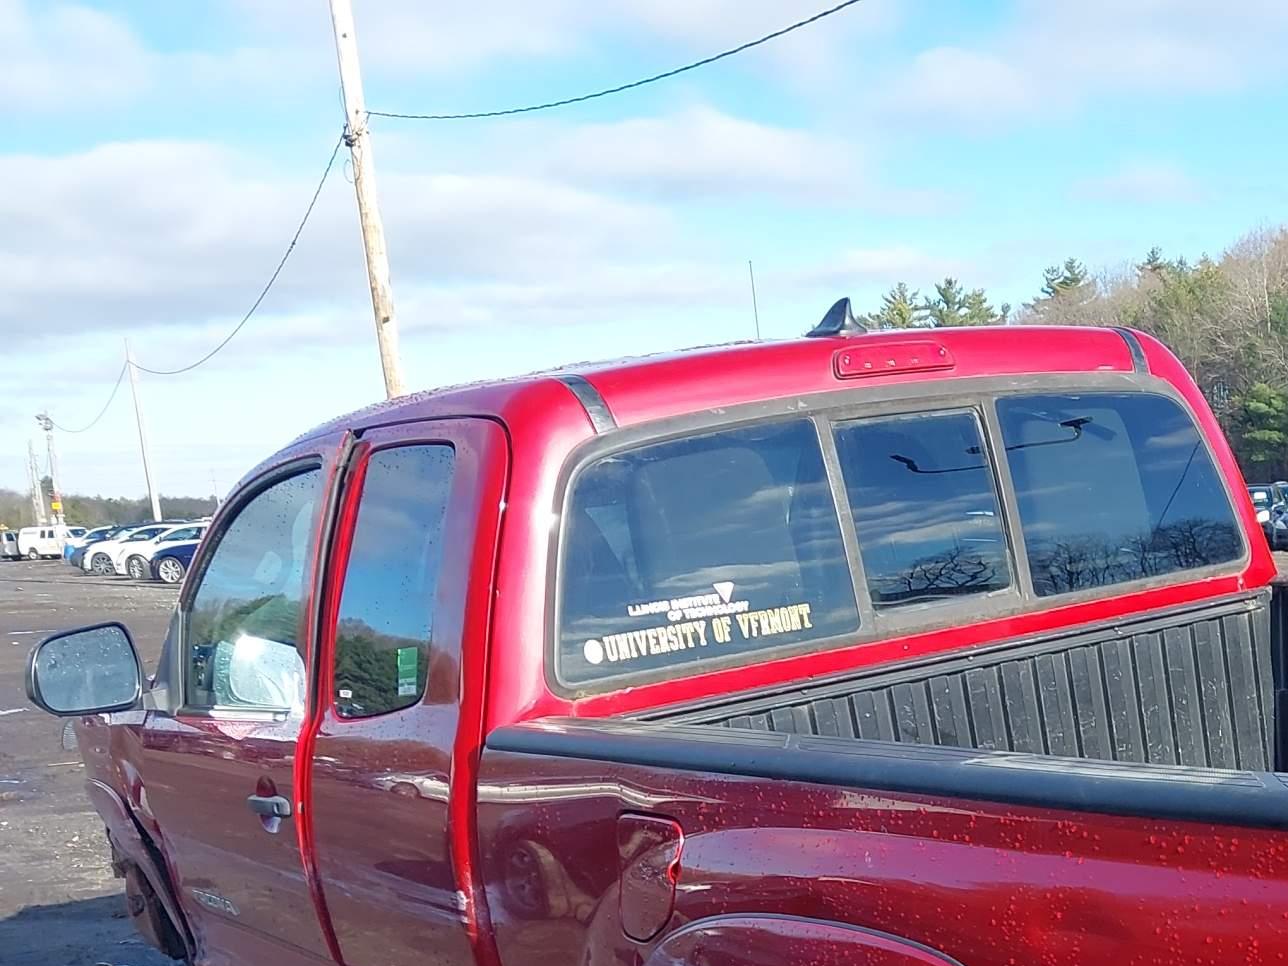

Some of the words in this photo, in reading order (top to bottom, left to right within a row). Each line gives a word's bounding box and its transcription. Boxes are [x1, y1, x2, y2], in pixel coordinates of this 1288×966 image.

[602, 620, 708, 662] UNIVERSITY
[712, 616, 733, 644] OF
[735, 603, 813, 639] VERMONT
